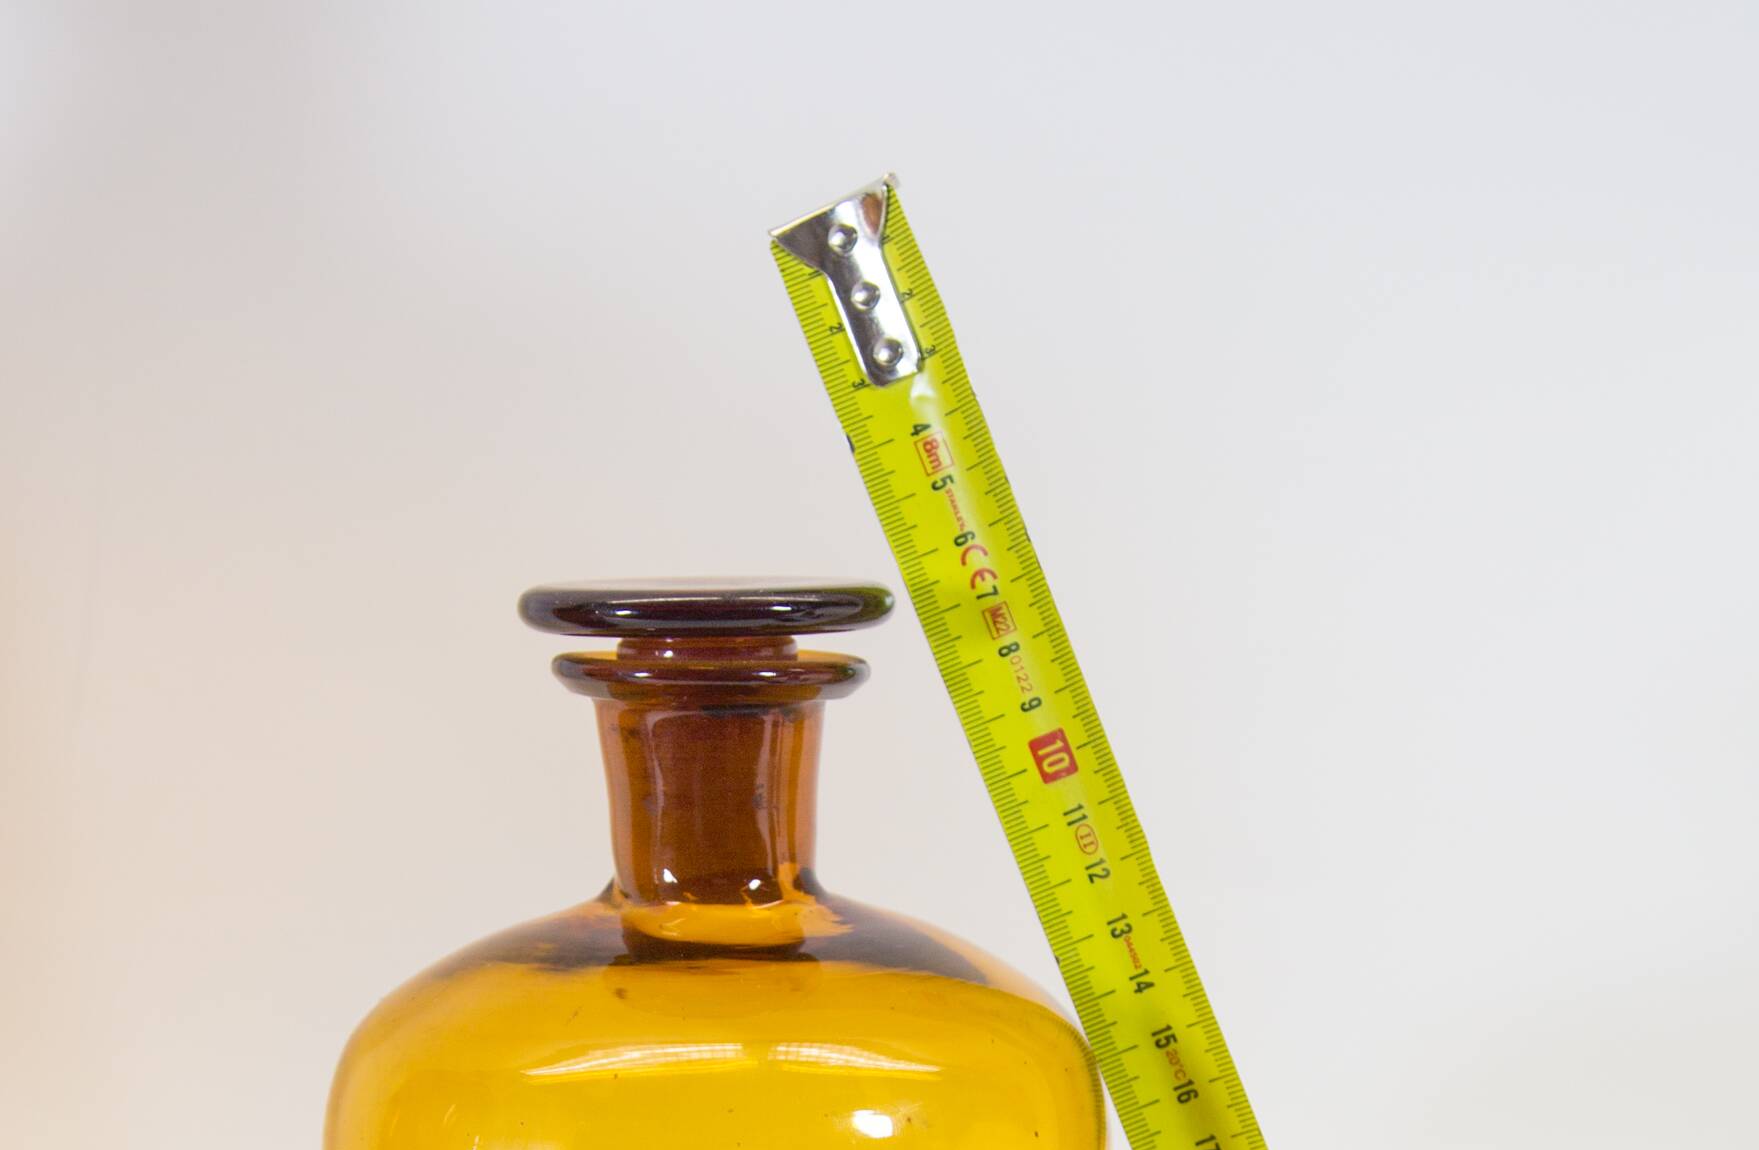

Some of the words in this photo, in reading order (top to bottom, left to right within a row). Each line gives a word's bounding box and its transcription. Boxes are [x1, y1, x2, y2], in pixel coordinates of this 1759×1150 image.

[903, 288, 914, 299] 2
[925, 344, 937, 355] 3
[829, 322, 843, 333] 2
[852, 378, 866, 389] 3
[910, 423, 931, 437] 4
[922, 438, 942, 470] 8m
[931, 474, 954, 491] 5
[953, 531, 976, 547] 6
[976, 585, 999, 600] 7
[998, 641, 1020, 658] 8
[1009, 655, 1033, 694] 0122
[1020, 697, 1042, 713] 9
[1037, 739, 1070, 774] 10
[1063, 803, 1088, 827] 11
[1084, 858, 1111, 884] 12
[1106, 913, 1133, 939] 13
[1129, 968, 1156, 994] 14
[1151, 1024, 1179, 1049] 15
[1173, 1079, 1199, 1104] 16
